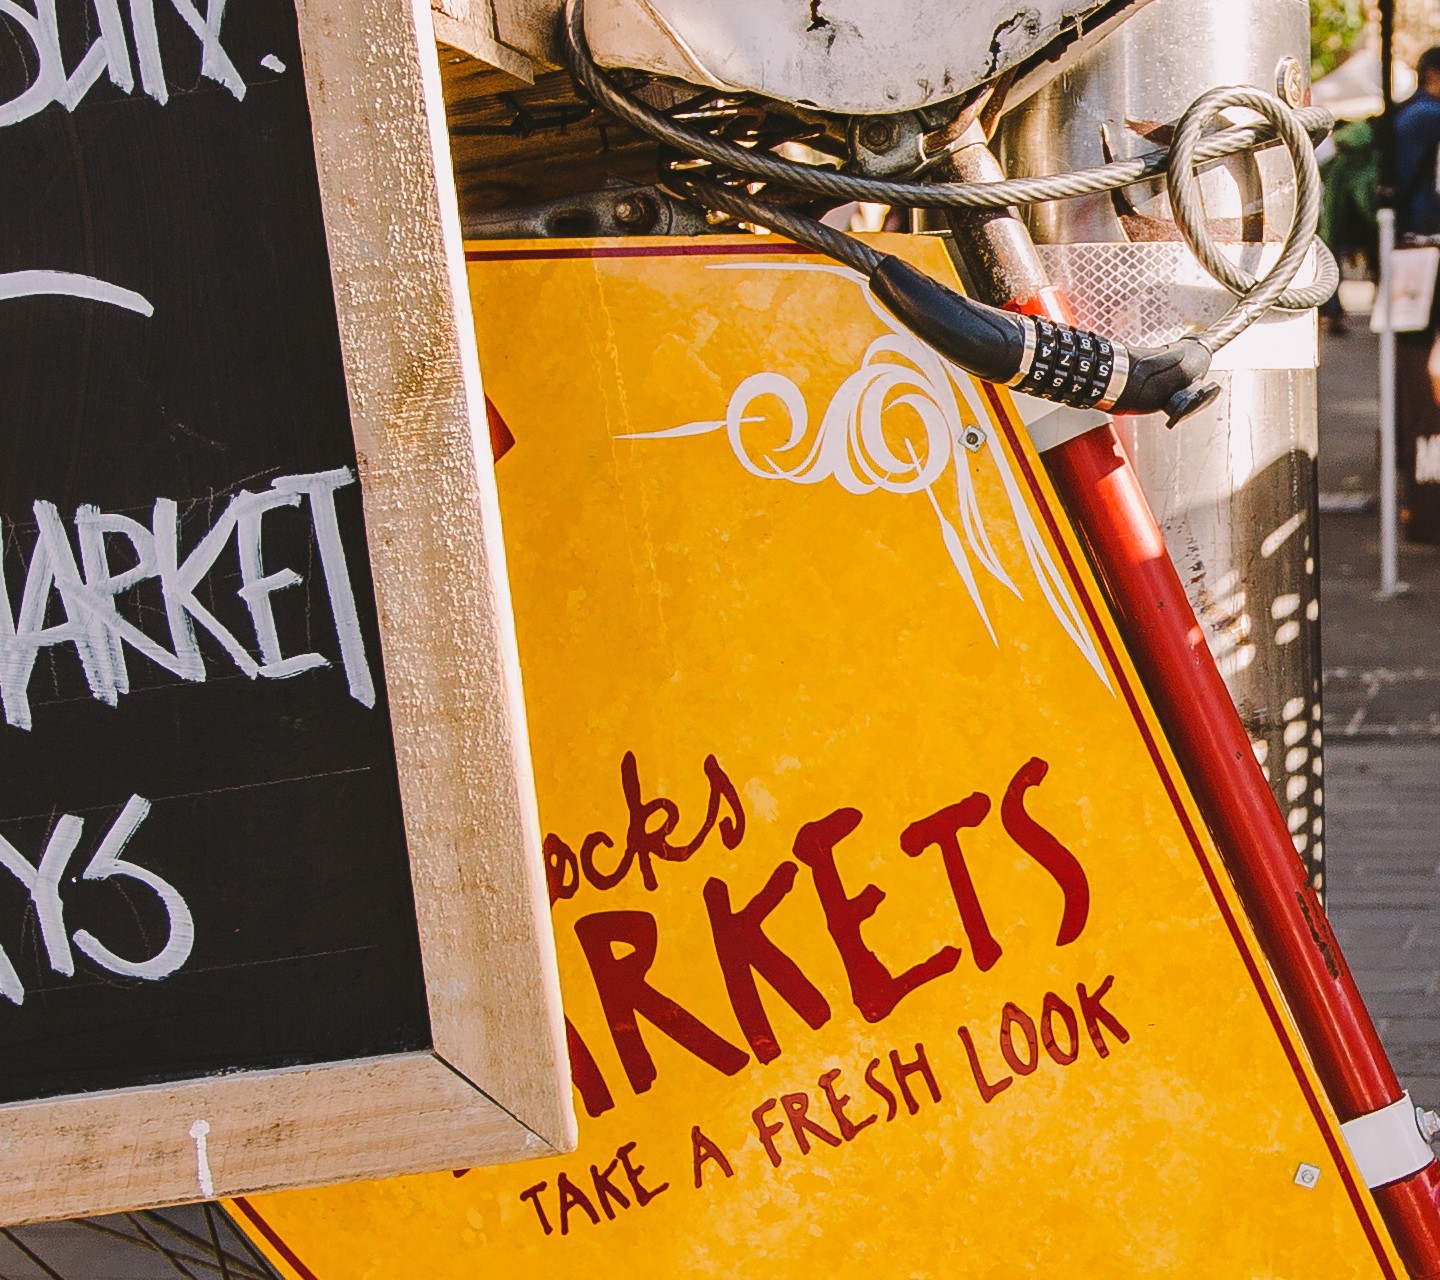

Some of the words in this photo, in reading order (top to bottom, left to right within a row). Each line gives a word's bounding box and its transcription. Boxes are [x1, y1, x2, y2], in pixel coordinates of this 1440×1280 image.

[543, 751, 745, 909] ocks
[564, 757, 1090, 1117] RKETS
[519, 1141, 670, 1236] TAKE
[691, 1125, 735, 1189] A
[751, 1042, 942, 1168] FRESH
[957, 974, 1130, 1104] LOOK
